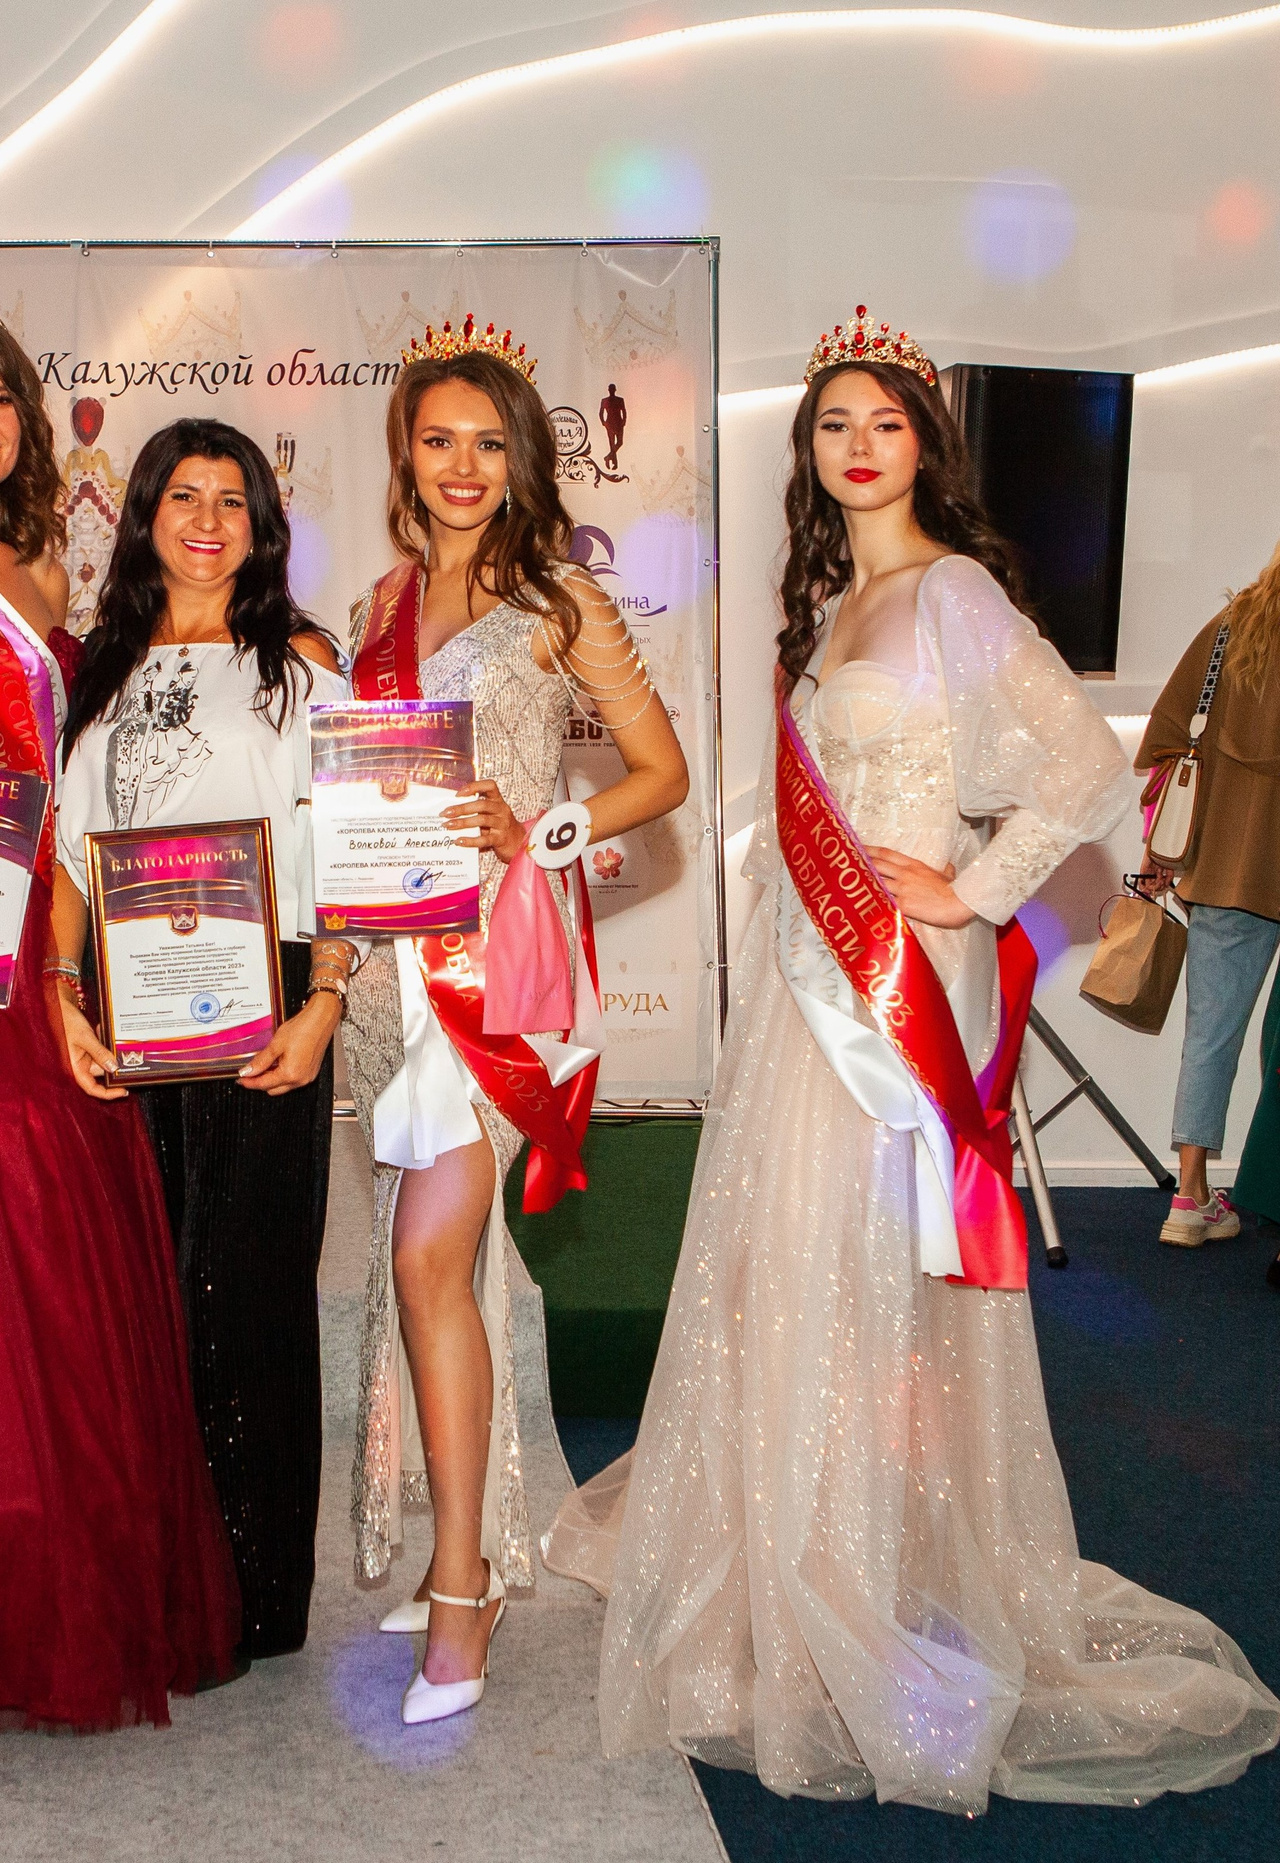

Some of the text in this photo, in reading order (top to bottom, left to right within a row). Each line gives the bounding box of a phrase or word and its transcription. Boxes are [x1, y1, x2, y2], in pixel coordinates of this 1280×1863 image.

[37, 351, 255, 398] Калужской
[267, 348, 404, 388] област
[613, 596, 651, 609] ина
[376, 592, 401, 701] КОРОЛЕВ
[377, 825, 418, 833] КАЛУЖСКОЙ
[349, 835, 455, 850] Волковой Александр
[110, 849, 249, 872] БЛАГОДАРНОСТЬ
[370, 860, 411, 868] КАЛУЖСКОЙ
[808, 816, 904, 962] КОРОЛЕВА
[789, 842, 867, 963] ОБЛАСТИ
[602, 992, 670, 1017] РУДА
[492, 1058, 551, 1112] 2023
